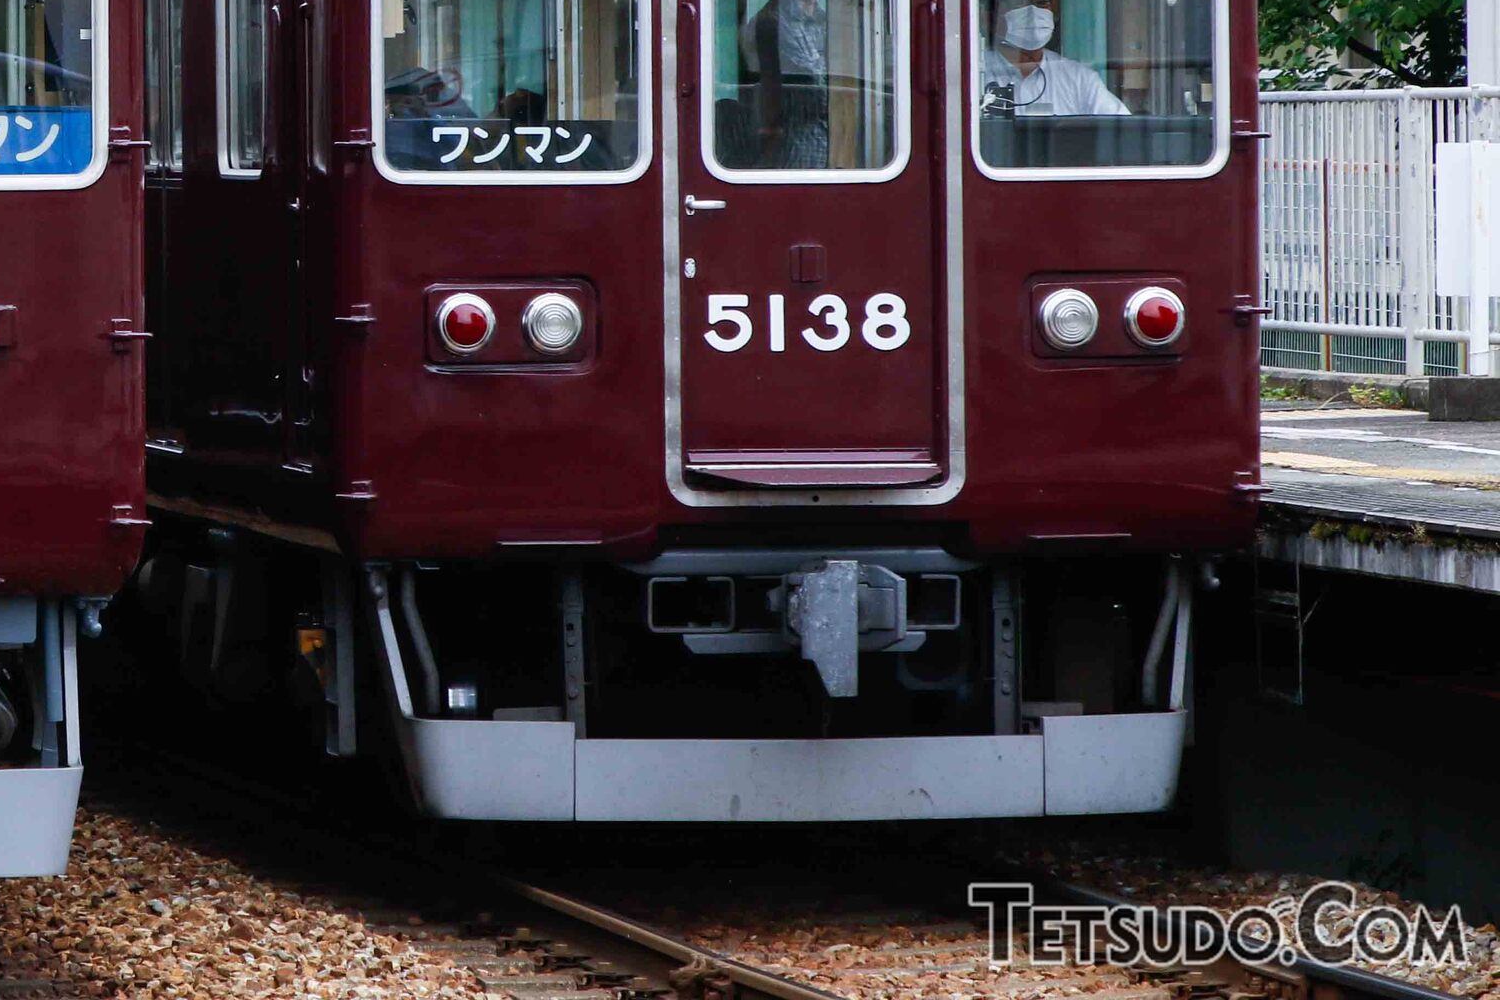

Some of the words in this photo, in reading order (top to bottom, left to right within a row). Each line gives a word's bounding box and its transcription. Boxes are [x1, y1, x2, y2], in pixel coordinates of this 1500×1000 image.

[431, 126, 593, 164] ワンマン
[703, 292, 912, 353] 5138
